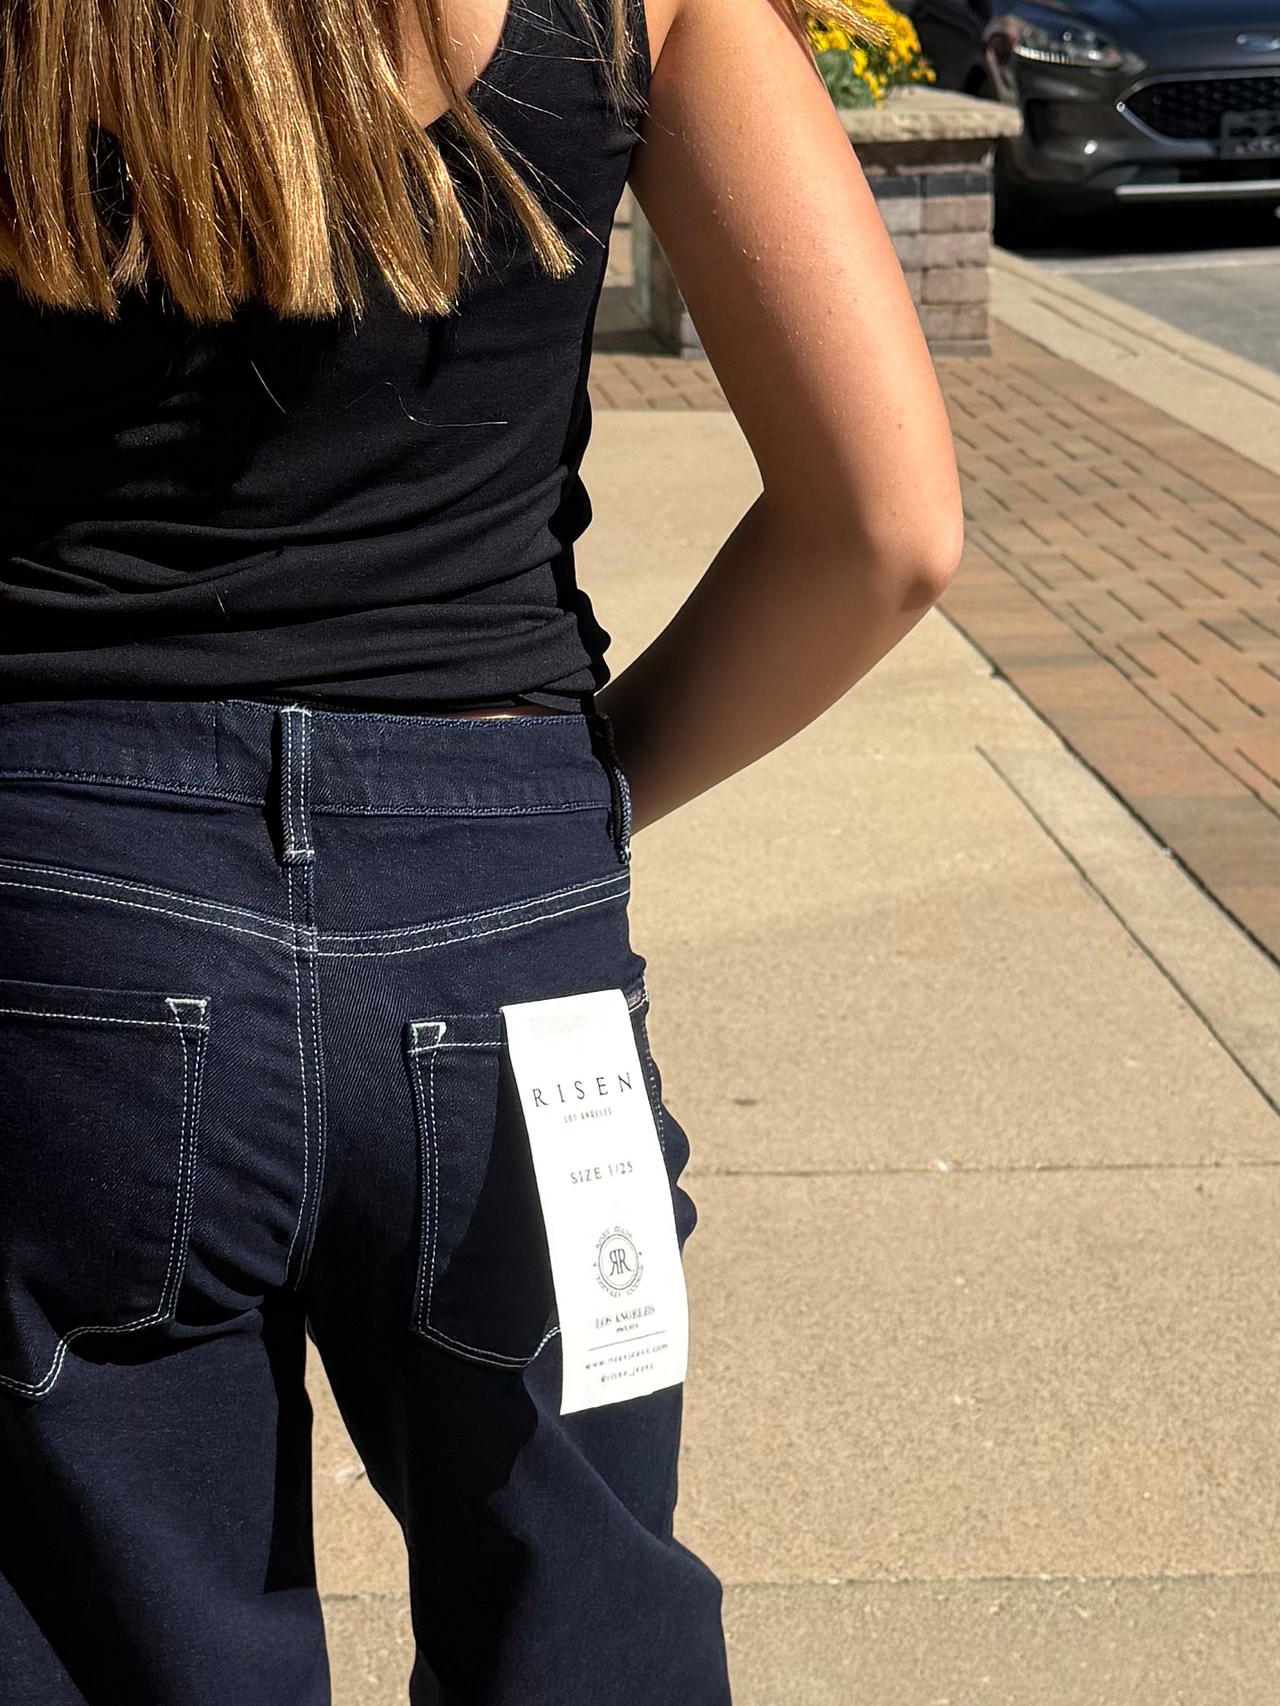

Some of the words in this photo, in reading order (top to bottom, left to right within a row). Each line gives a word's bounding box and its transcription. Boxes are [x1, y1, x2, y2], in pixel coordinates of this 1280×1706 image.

[532, 1072, 634, 1107] RISEN
[570, 1166, 603, 1185] SIZE
[608, 1160, 634, 1179] 1/25
